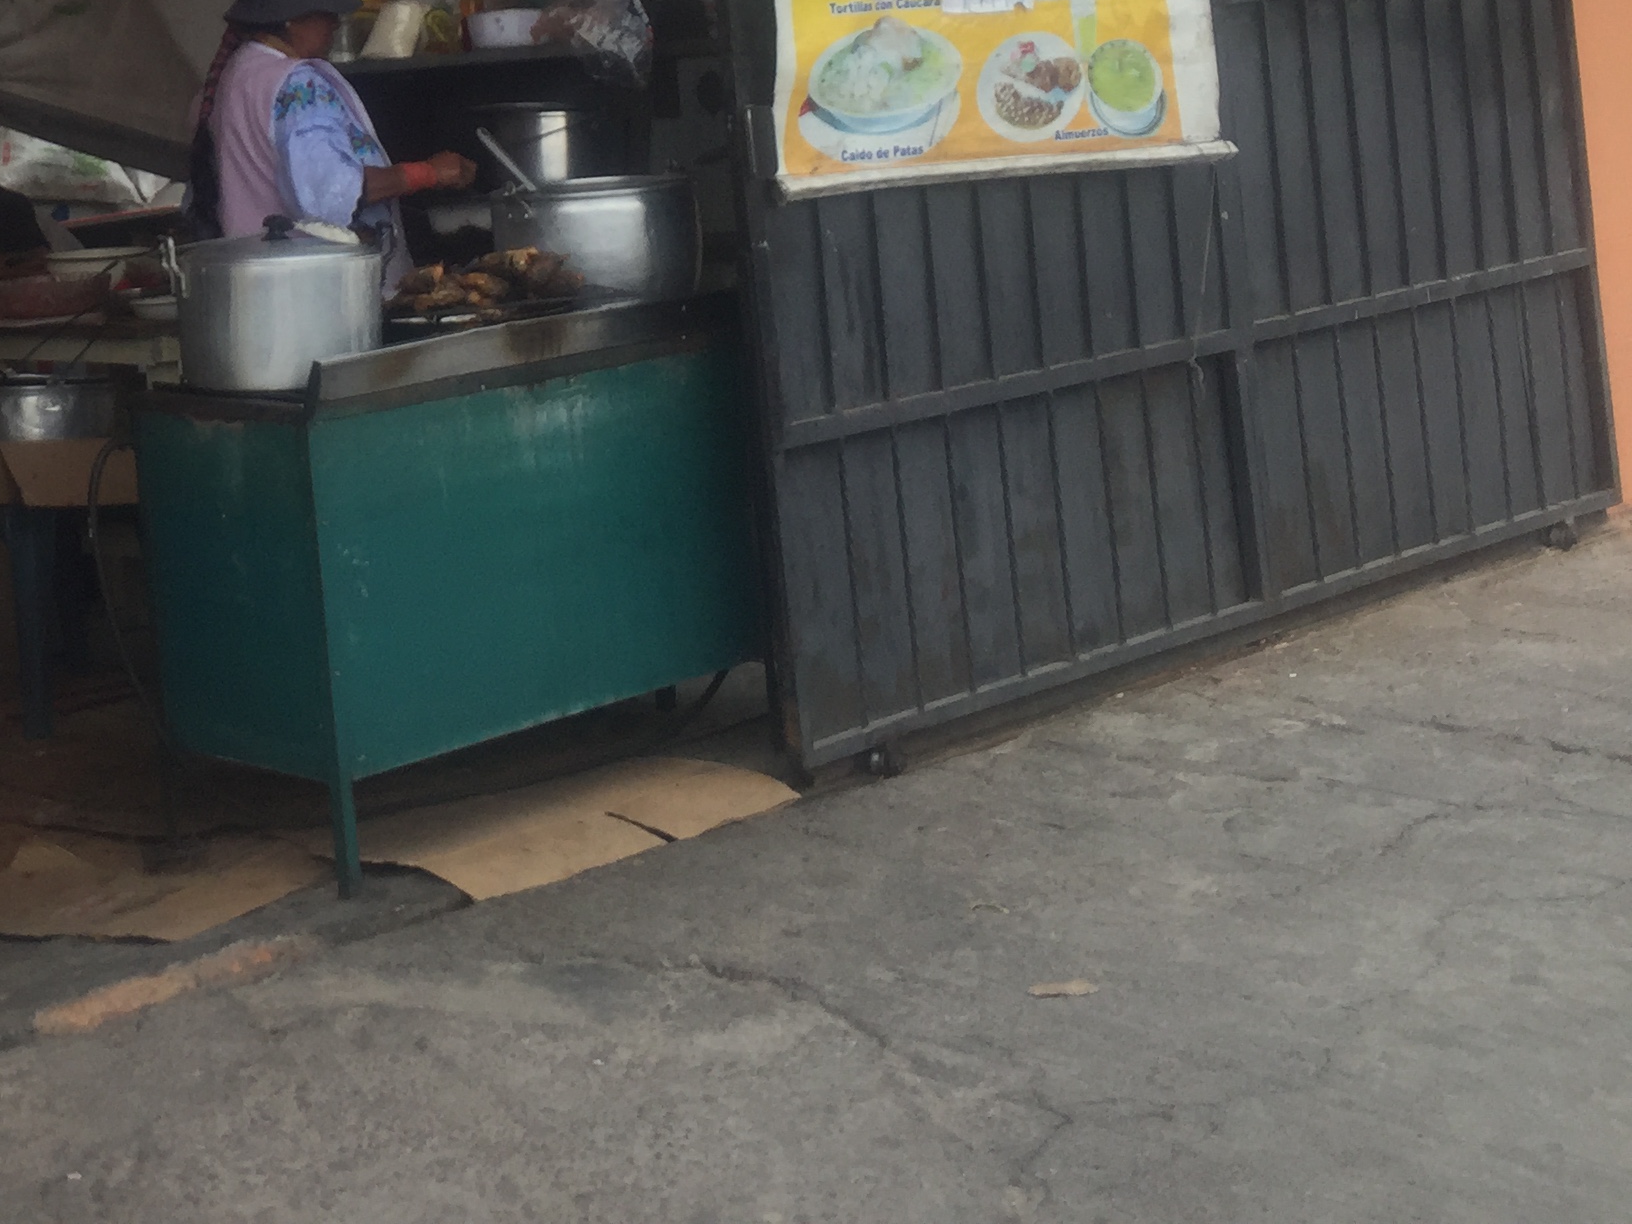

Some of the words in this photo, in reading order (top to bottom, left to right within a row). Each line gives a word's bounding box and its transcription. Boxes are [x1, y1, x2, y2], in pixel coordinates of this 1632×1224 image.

[829, 1, 872, 14] Tortillas
[875, 0, 893, 10] con
[1054, 127, 1108, 141] Almuerzos
[841, 148, 873, 162] Caldo
[876, 147, 889, 159] de
[893, 145, 924, 157] Patas
